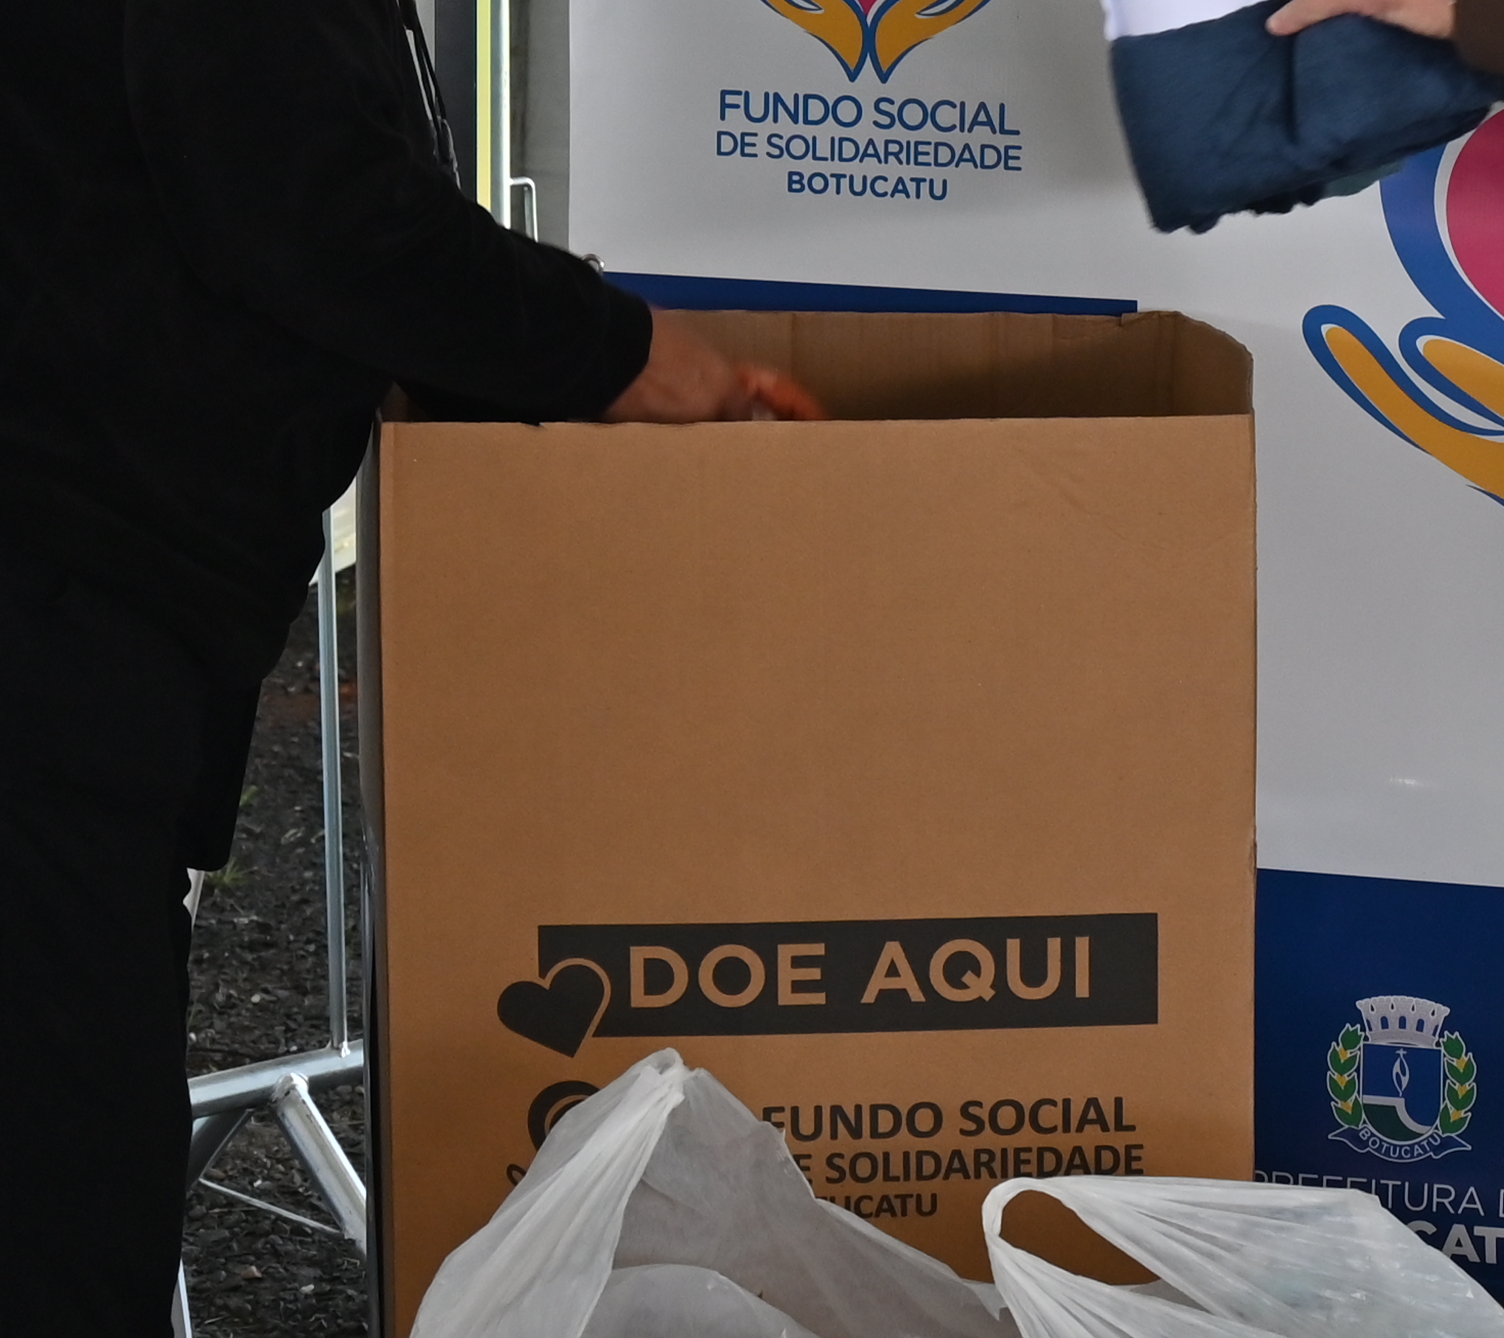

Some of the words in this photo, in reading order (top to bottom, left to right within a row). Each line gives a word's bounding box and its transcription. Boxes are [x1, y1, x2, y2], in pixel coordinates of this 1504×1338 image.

[718, 88, 864, 129] FUNDO
[872, 96, 1021, 136] SOCIAL
[716, 130, 759, 158] DE
[765, 132, 1023, 172] SOLIDARIEDADE
[787, 169, 948, 201] BOTUCATU
[628, 941, 827, 1010] DOE
[860, 935, 1091, 1004] AQUI
[958, 1096, 1137, 1138] SOCIAL
[793, 1152, 813, 1185] E
[824, 1143, 1145, 1185] SOLIDARIEDADE
[1358, 1126, 1442, 1160] BOTUCATU
